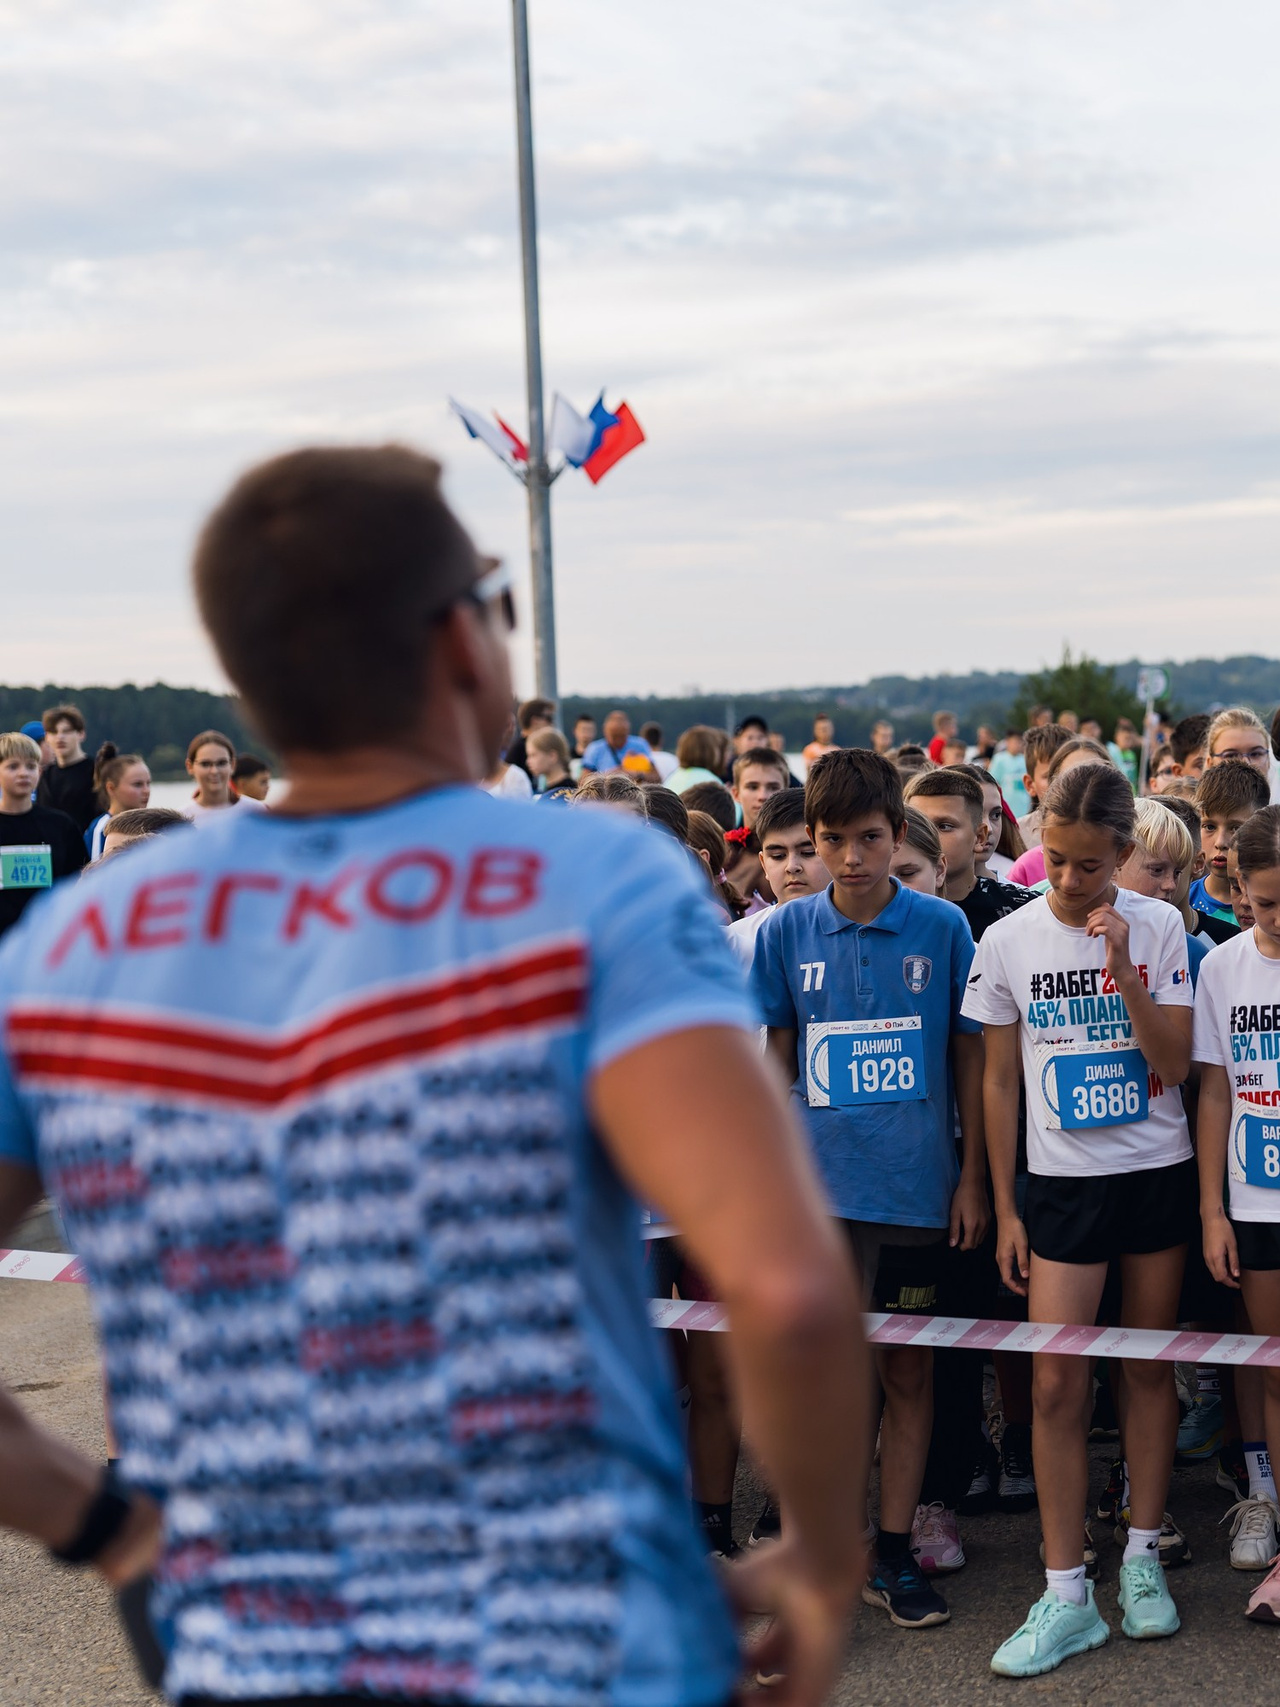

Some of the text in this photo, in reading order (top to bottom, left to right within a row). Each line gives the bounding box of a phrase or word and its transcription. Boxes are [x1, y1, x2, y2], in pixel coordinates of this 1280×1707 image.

[11, 865, 48, 883] 4972
[47, 846, 543, 971] ЛЕГКОВ
[800, 961, 825, 992] 77
[1031, 964, 1149, 1001] #ЗАБЕГ25
[1027, 992, 1132, 1029] 45% ПЛАН
[852, 1038, 902, 1056] ДАНИИЛ
[1086, 1022, 1132, 1042] БЕГУ
[1230, 1033, 1258, 1063] 5%
[848, 1056, 915, 1093] 1928
[1085, 1062, 1125, 1082] ДИАНА
[1072, 1081, 1140, 1120] 3686
